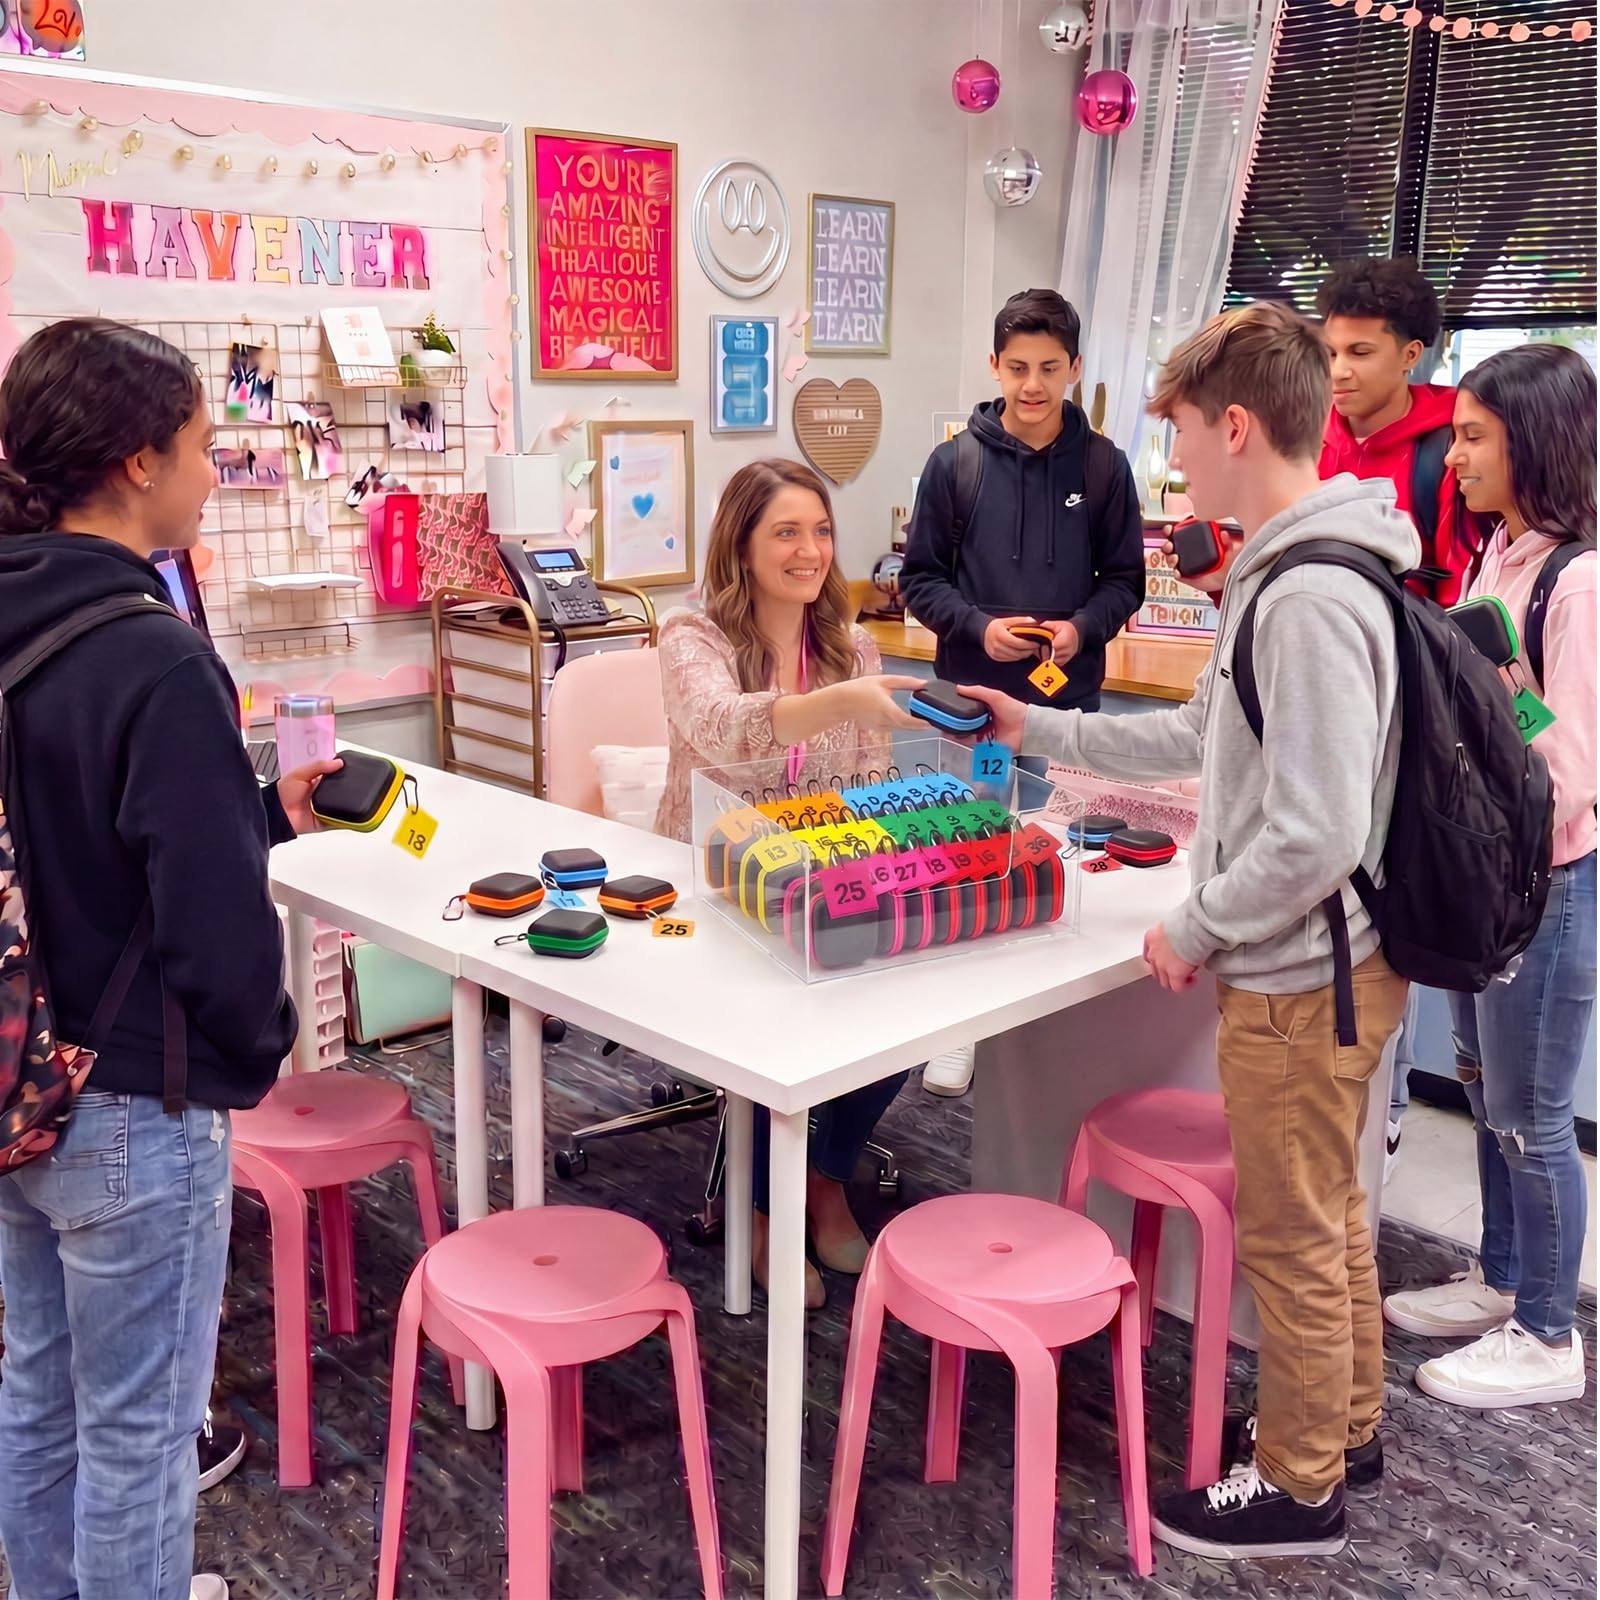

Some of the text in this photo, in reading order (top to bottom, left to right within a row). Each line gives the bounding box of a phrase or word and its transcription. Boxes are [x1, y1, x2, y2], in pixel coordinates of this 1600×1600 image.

[553, 153, 660, 197] YOU'RE
[549, 190, 661, 226] AMAZING
[546, 217, 665, 253] INTELLIGENT
[815, 207, 887, 244] LEARN
[81, 199, 431, 290] HAVENER
[815, 243, 886, 278] LEARN
[549, 274, 662, 306] AWESOME
[814, 277, 885, 312] LEARN
[549, 305, 663, 334] MAGICAL
[813, 311, 885, 344] LEARN
[980, 759, 1003, 775] 12
[407, 828, 427, 852] 18
[765, 845, 788, 862] 13
[1023, 835, 1051, 856] 36
[895, 863, 917, 882] 27
[924, 858, 946, 875] 18
[948, 853, 971, 870] 19
[1089, 861, 1109, 873] 28
[833, 880, 867, 906] 25
[659, 923, 688, 936] 25
